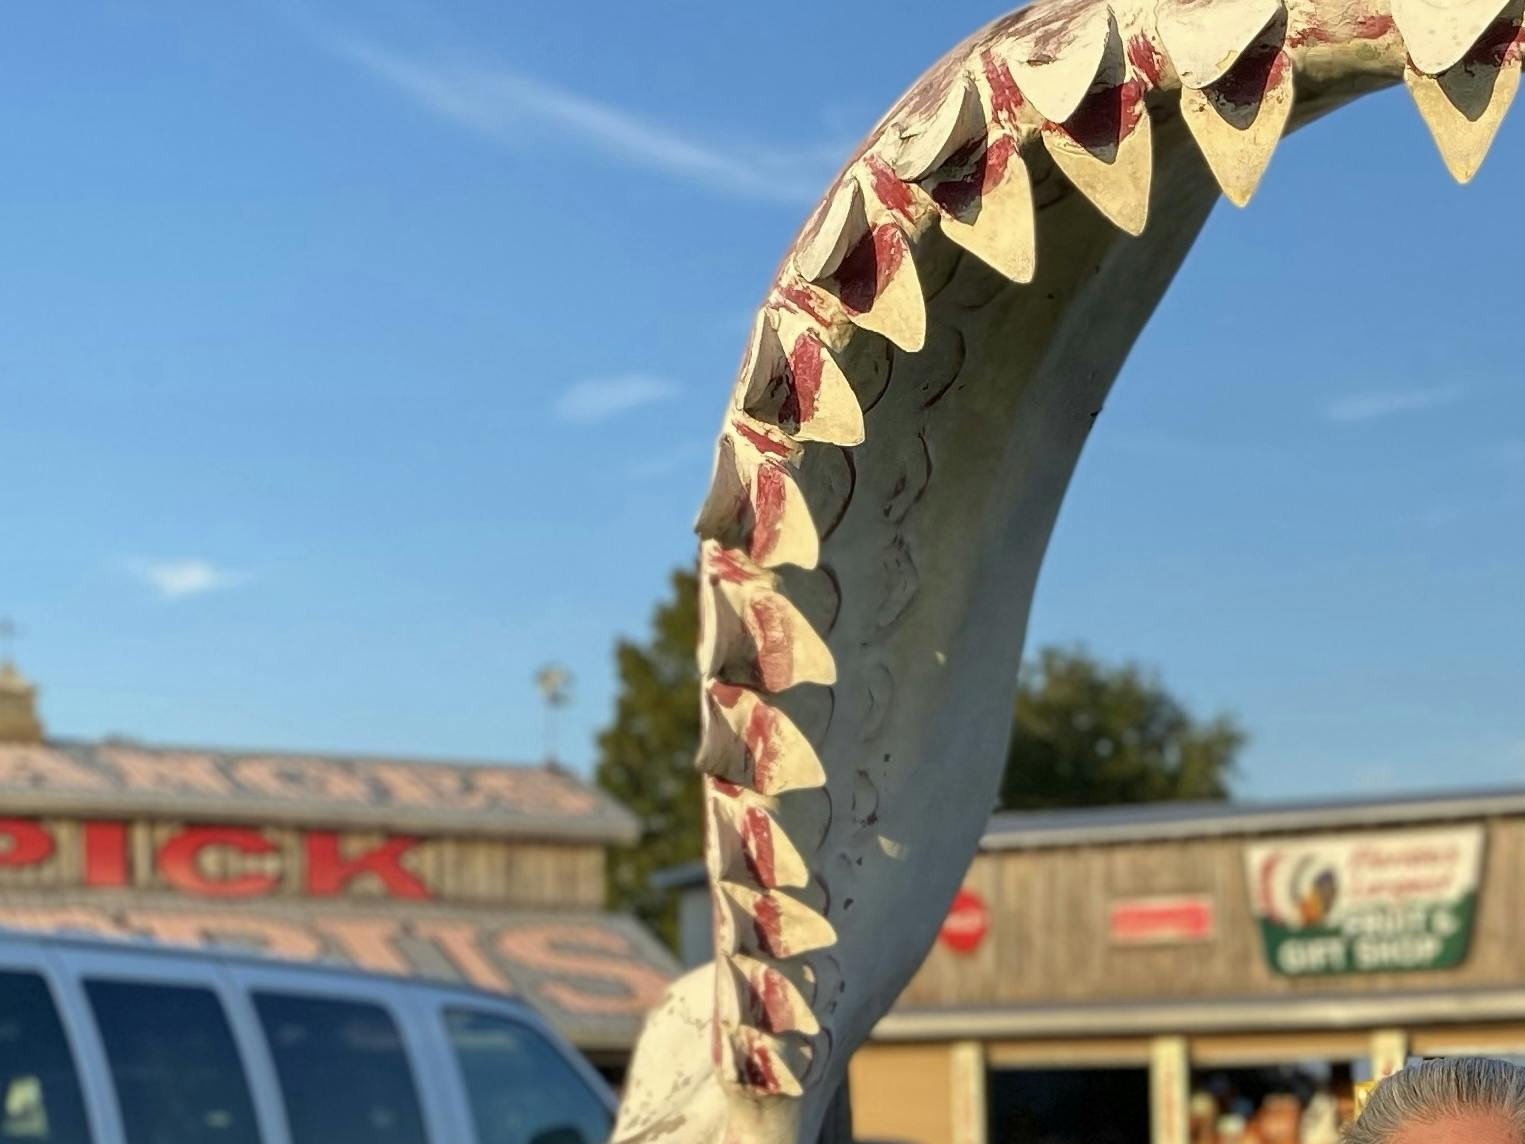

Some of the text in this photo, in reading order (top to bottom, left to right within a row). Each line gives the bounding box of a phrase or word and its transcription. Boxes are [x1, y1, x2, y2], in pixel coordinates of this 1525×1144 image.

[1344, 904, 1428, 939] FRUIT
[1276, 934, 1443, 974] GIFT SHOP
